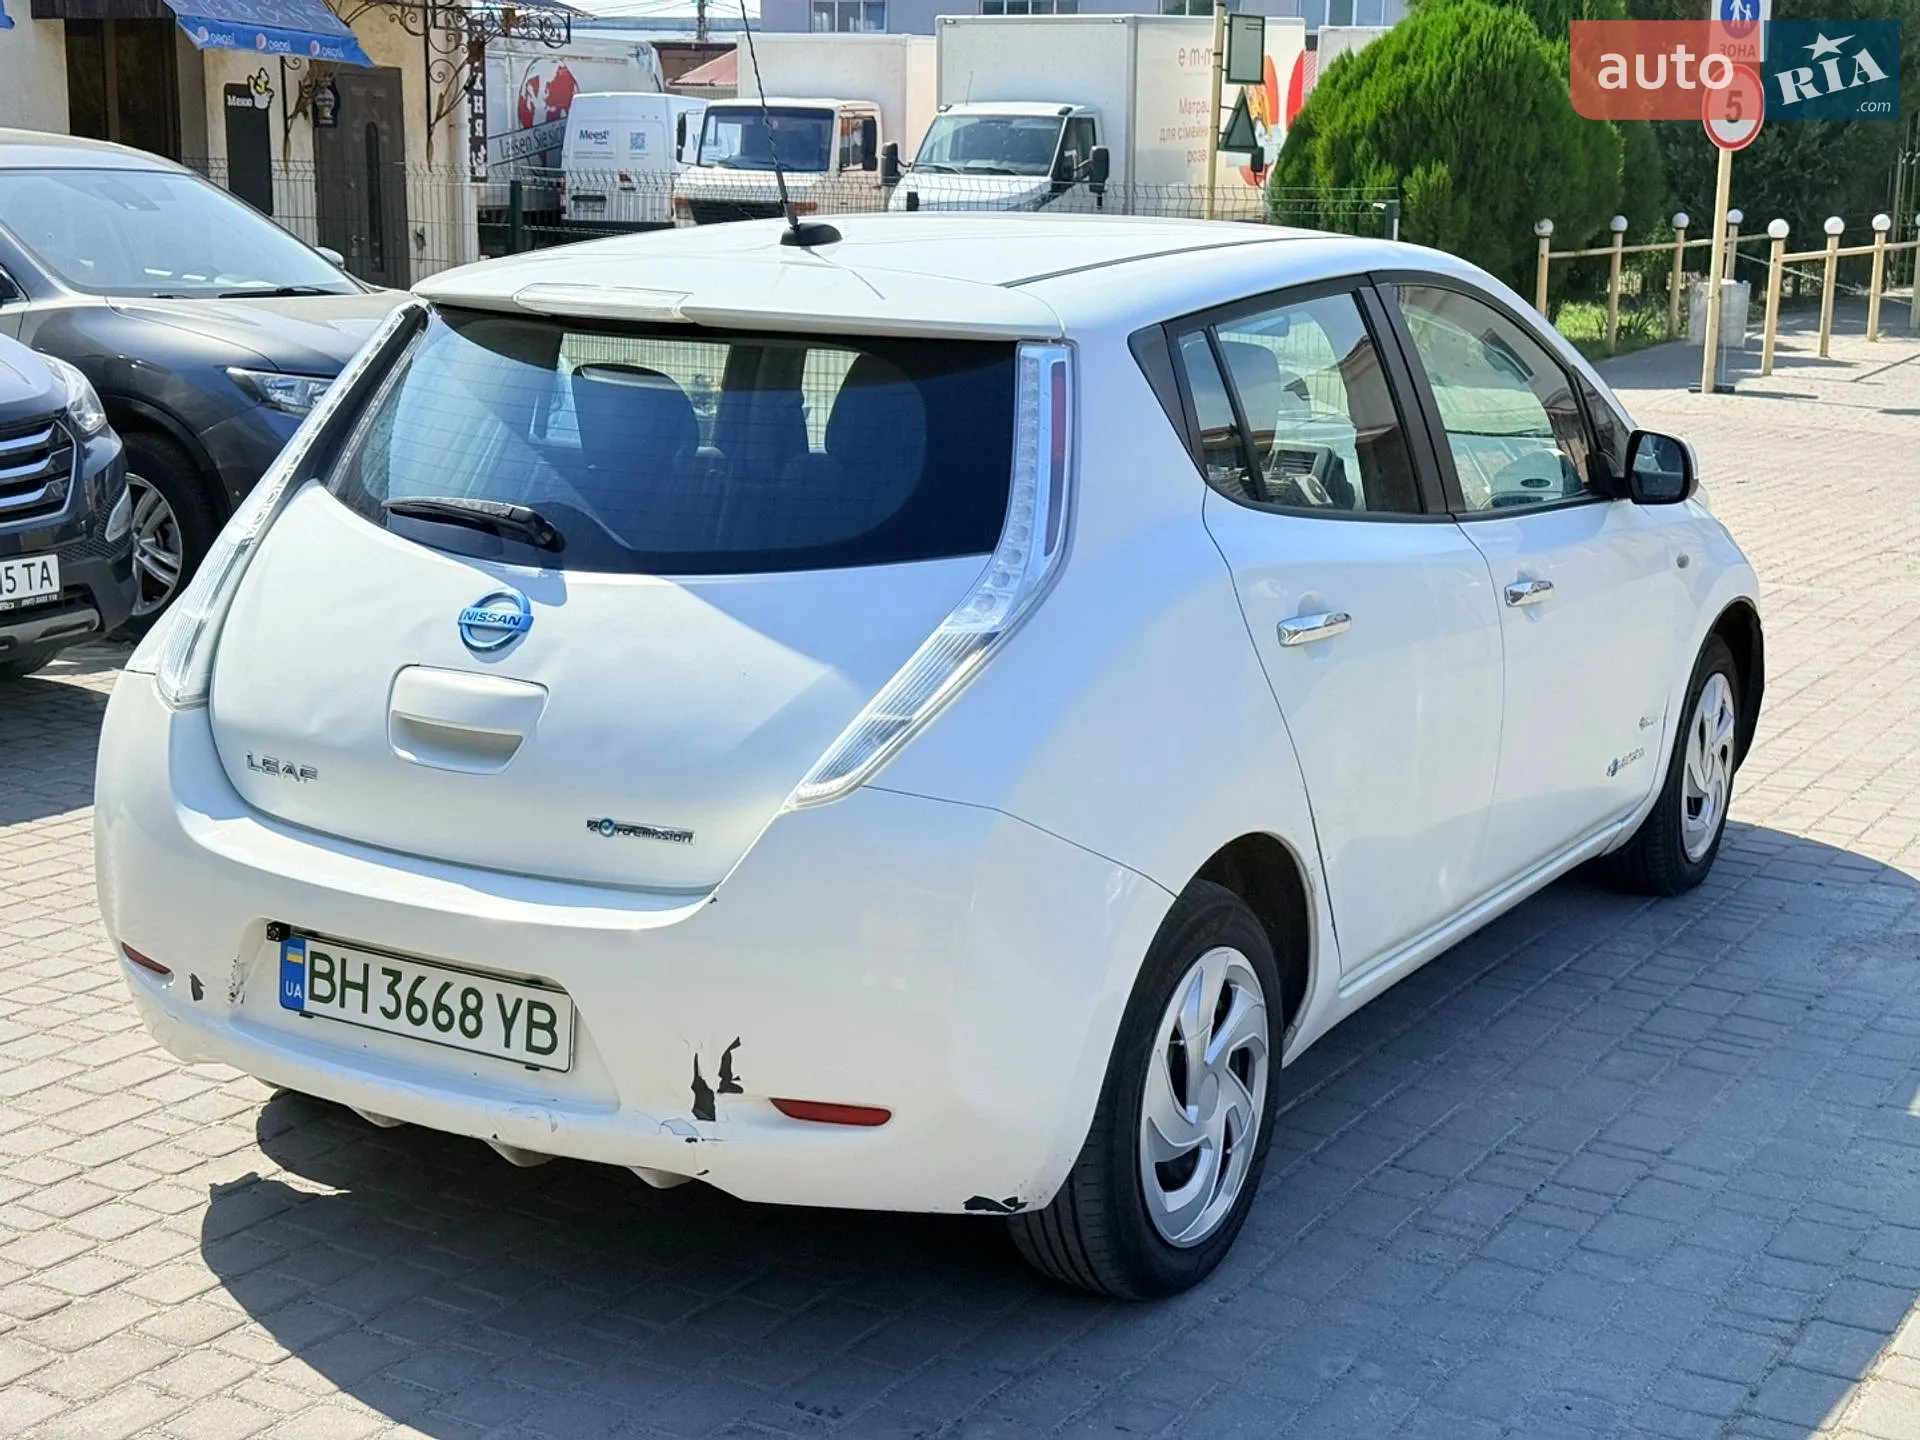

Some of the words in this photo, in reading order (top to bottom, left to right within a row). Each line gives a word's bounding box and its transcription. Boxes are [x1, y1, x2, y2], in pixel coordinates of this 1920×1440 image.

[267, 39, 292, 52] pepsi
[1725, 90, 1743, 123] 5
[579, 129, 608, 140] Meest
[21, 561, 53, 591] TA
[463, 611, 522, 626] NISSAN
[247, 751, 318, 782] LEAF
[285, 980, 302, 999] UA
[379, 966, 484, 1040] 3668
